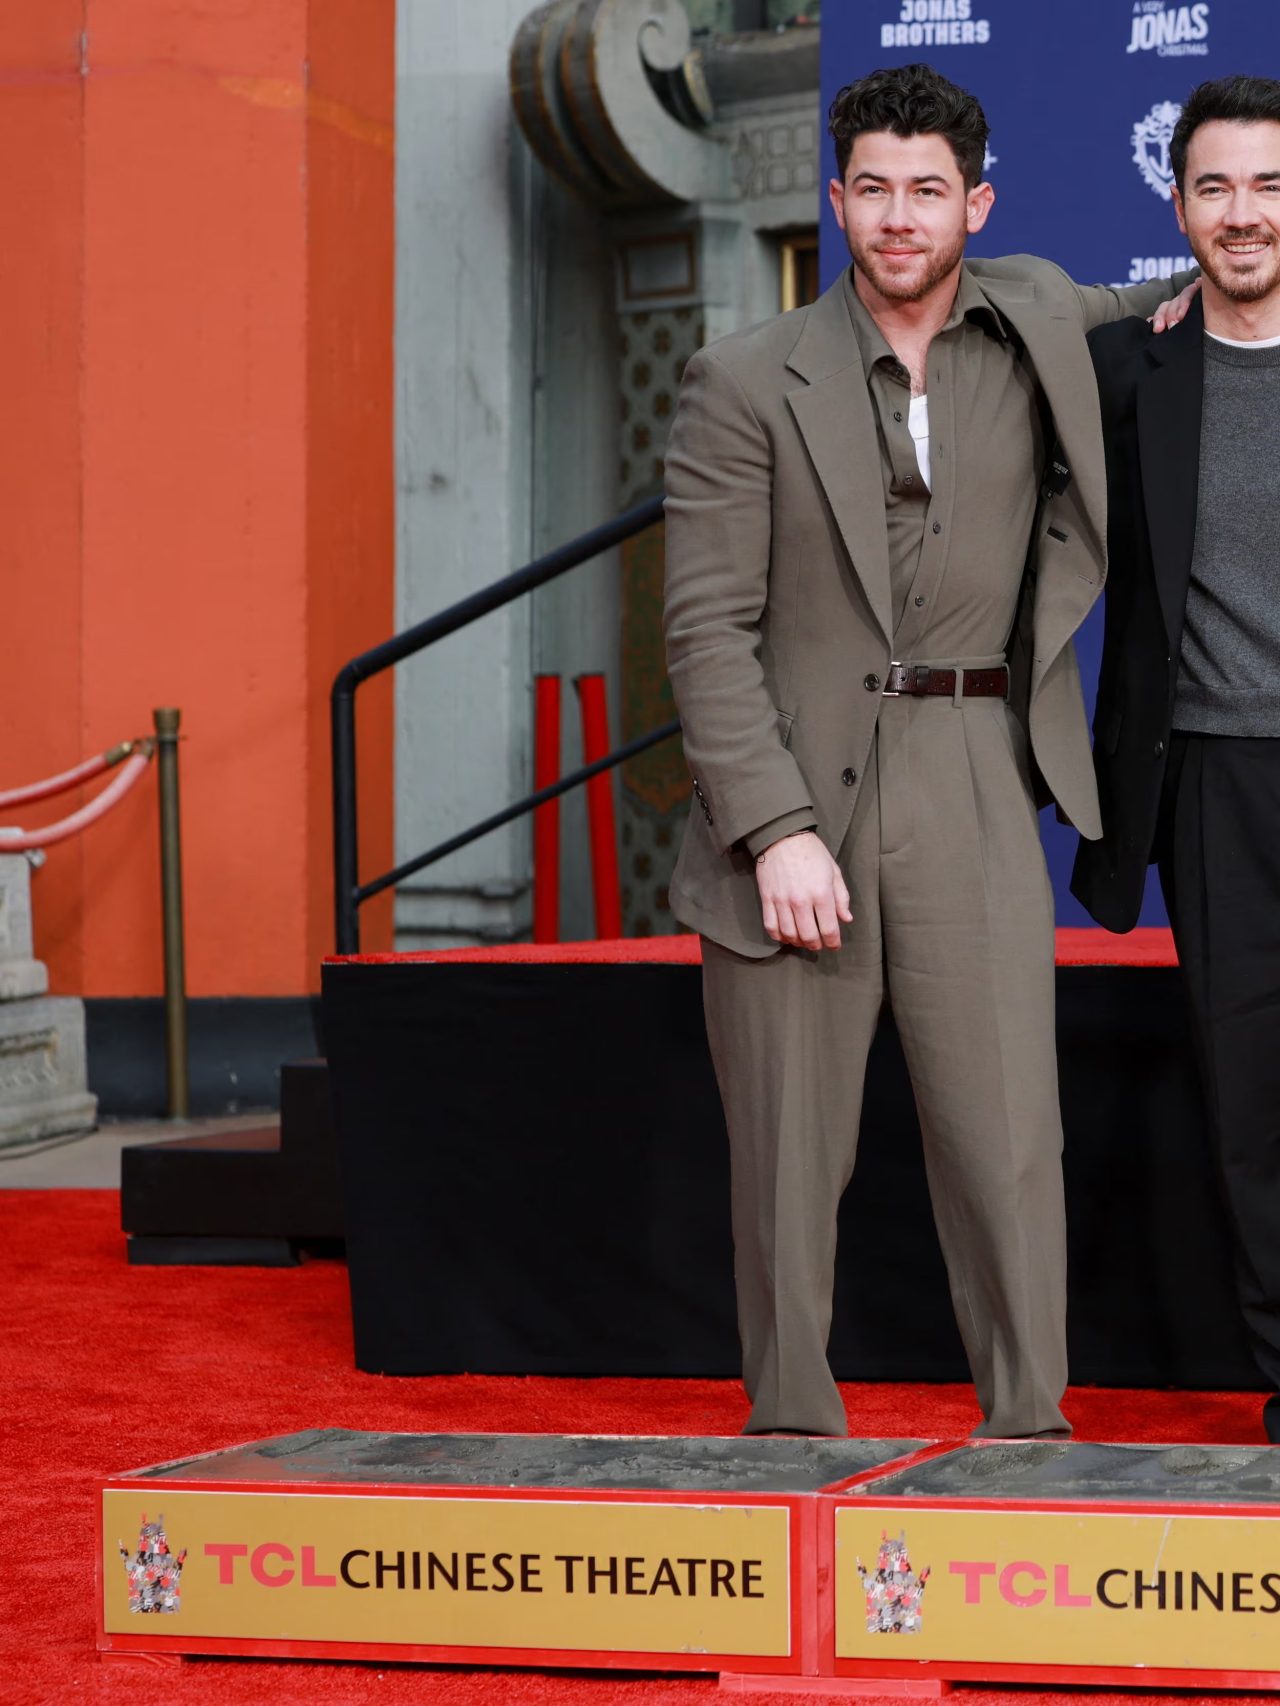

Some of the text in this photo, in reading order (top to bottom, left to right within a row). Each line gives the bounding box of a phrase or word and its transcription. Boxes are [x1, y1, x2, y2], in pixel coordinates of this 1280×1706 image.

[881, 20, 990, 47] BROTHERS
[900, 0, 971, 21] JONAS
[1126, 3, 1209, 53] JONAS
[204, 1542, 765, 1598] TCL CHINESE THEATRE
[949, 1561, 1091, 1607] TCL
